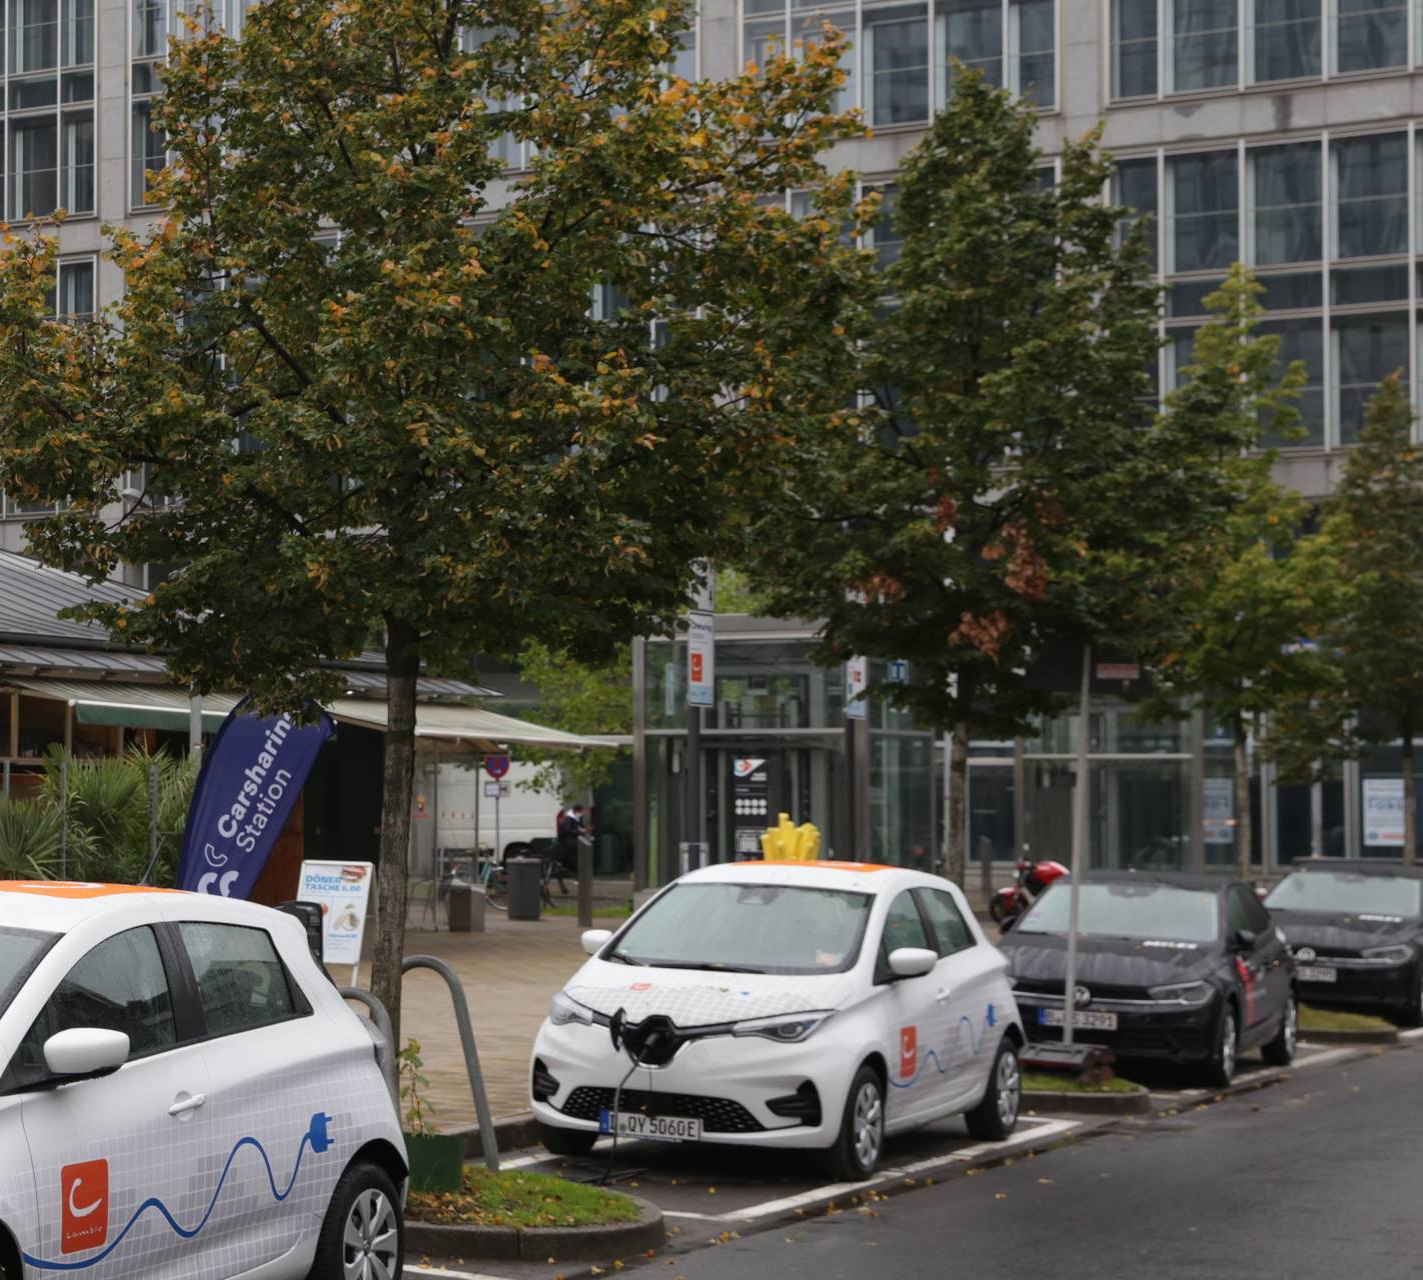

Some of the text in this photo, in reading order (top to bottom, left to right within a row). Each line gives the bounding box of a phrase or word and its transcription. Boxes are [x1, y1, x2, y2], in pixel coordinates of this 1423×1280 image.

[218, 712, 292, 838] Carsharin
[236, 769, 292, 852] Station
[305, 875, 341, 884] DÖNER
